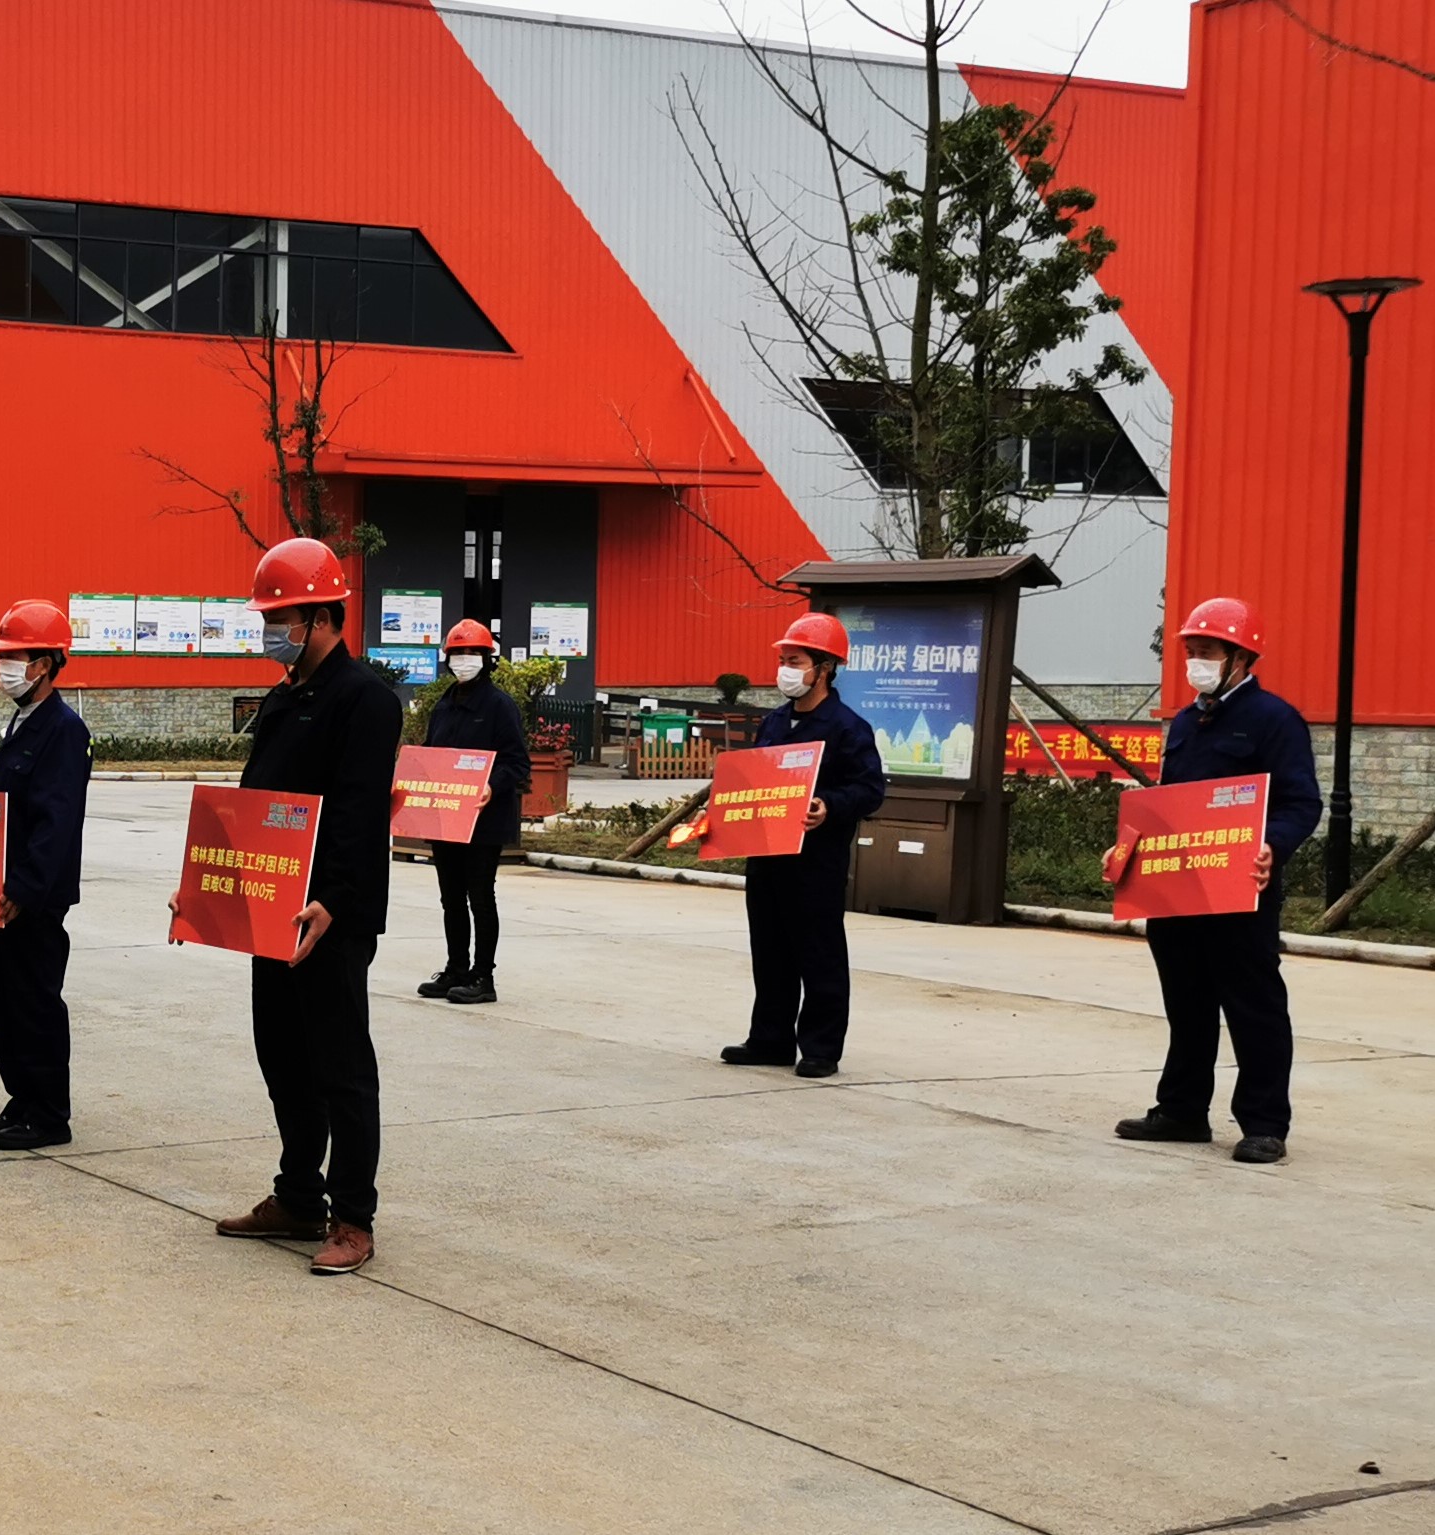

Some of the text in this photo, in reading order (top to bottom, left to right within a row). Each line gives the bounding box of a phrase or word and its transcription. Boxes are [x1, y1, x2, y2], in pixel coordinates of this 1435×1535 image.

[846, 644, 980, 674] 垃圾分类 绿色环保
[190, 845, 301, 877] 格林美基层员工纾困帮扶
[1141, 852, 1229, 874] 困难B级 2000元
[201, 873, 276, 901] 困难C级 1000元
